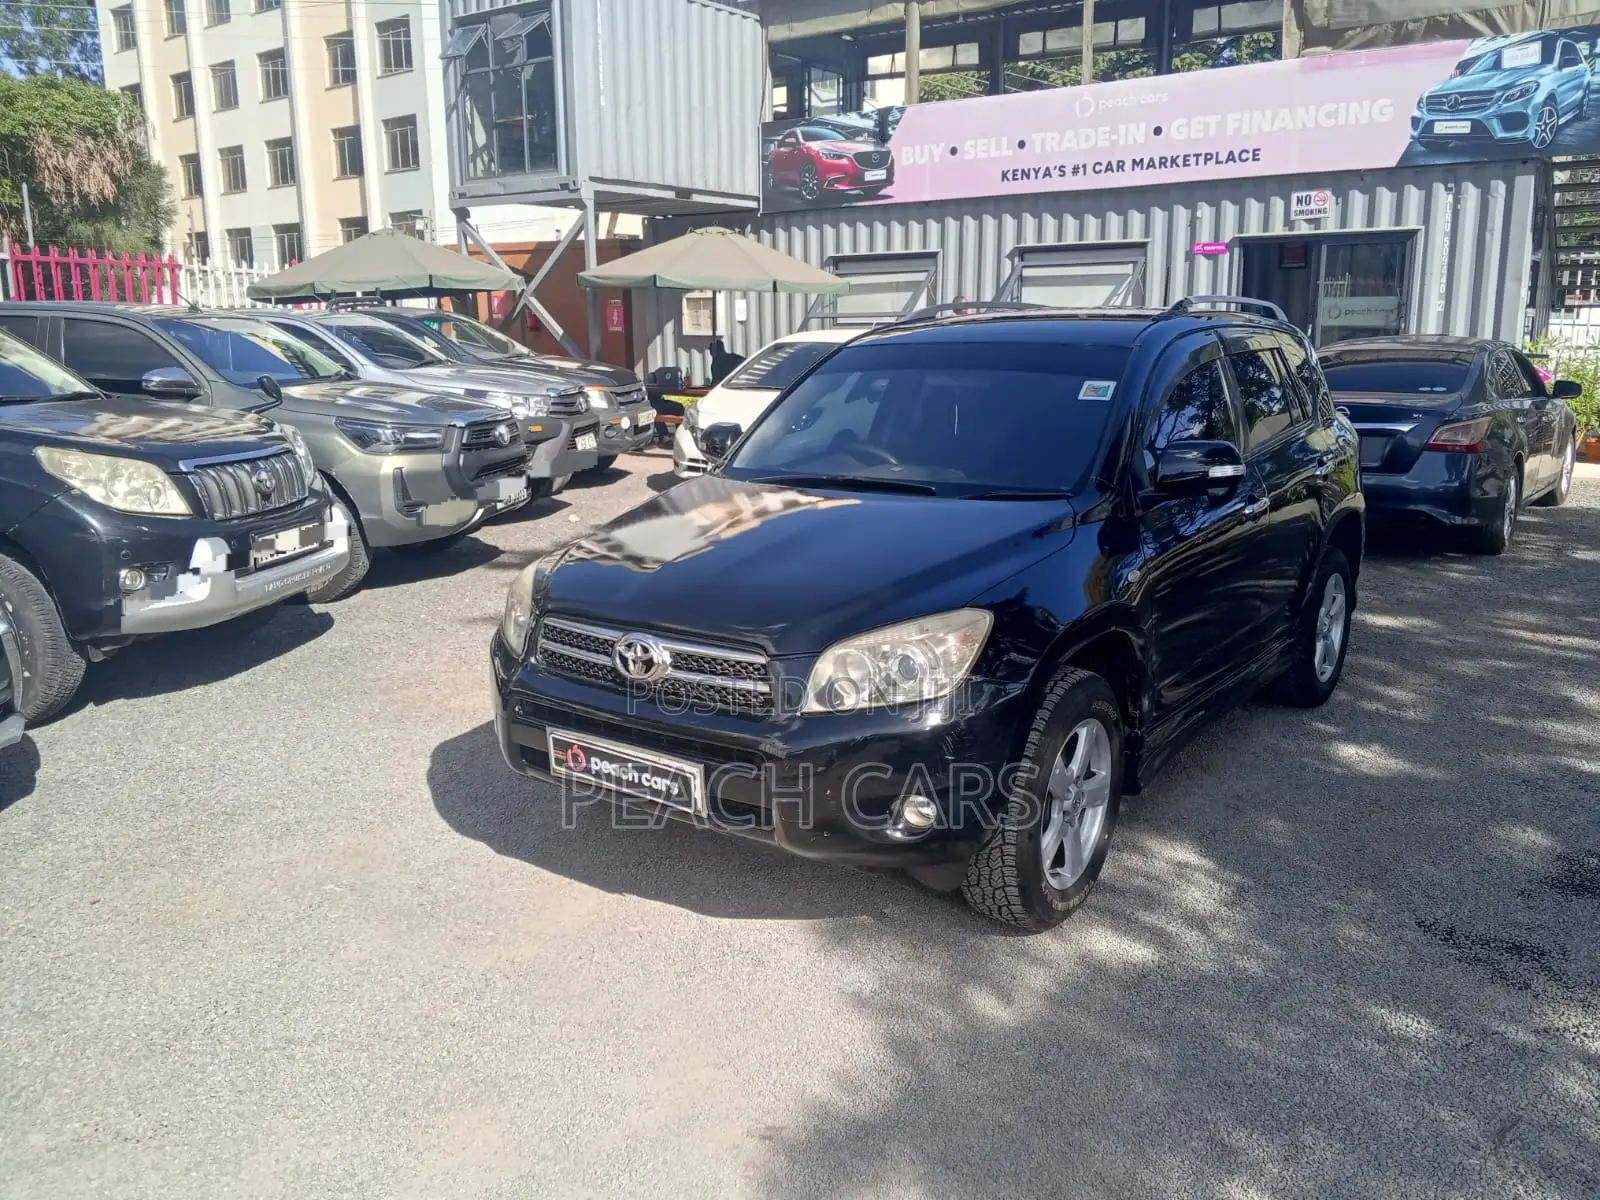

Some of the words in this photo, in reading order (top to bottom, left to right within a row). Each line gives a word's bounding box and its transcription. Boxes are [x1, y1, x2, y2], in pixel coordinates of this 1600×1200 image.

[1099, 90, 1138, 114] peach
[1140, 92, 1169, 105] cars
[901, 143, 945, 166] BUY
[964, 136, 1013, 160] SELL
[1031, 122, 1147, 153] TRADE-IN
[1169, 114, 1222, 141] GET
[1225, 98, 1395, 136] FINANCING
[1071, 163, 1088, 177] #1
[1092, 158, 1126, 174] CAR
[1131, 147, 1262, 172] MARKETPLACE
[1294, 207, 1328, 217] SMOKING
[1296, 193, 1312, 206] NO
[590, 756, 638, 782] peach
[641, 772, 679, 796] cars
